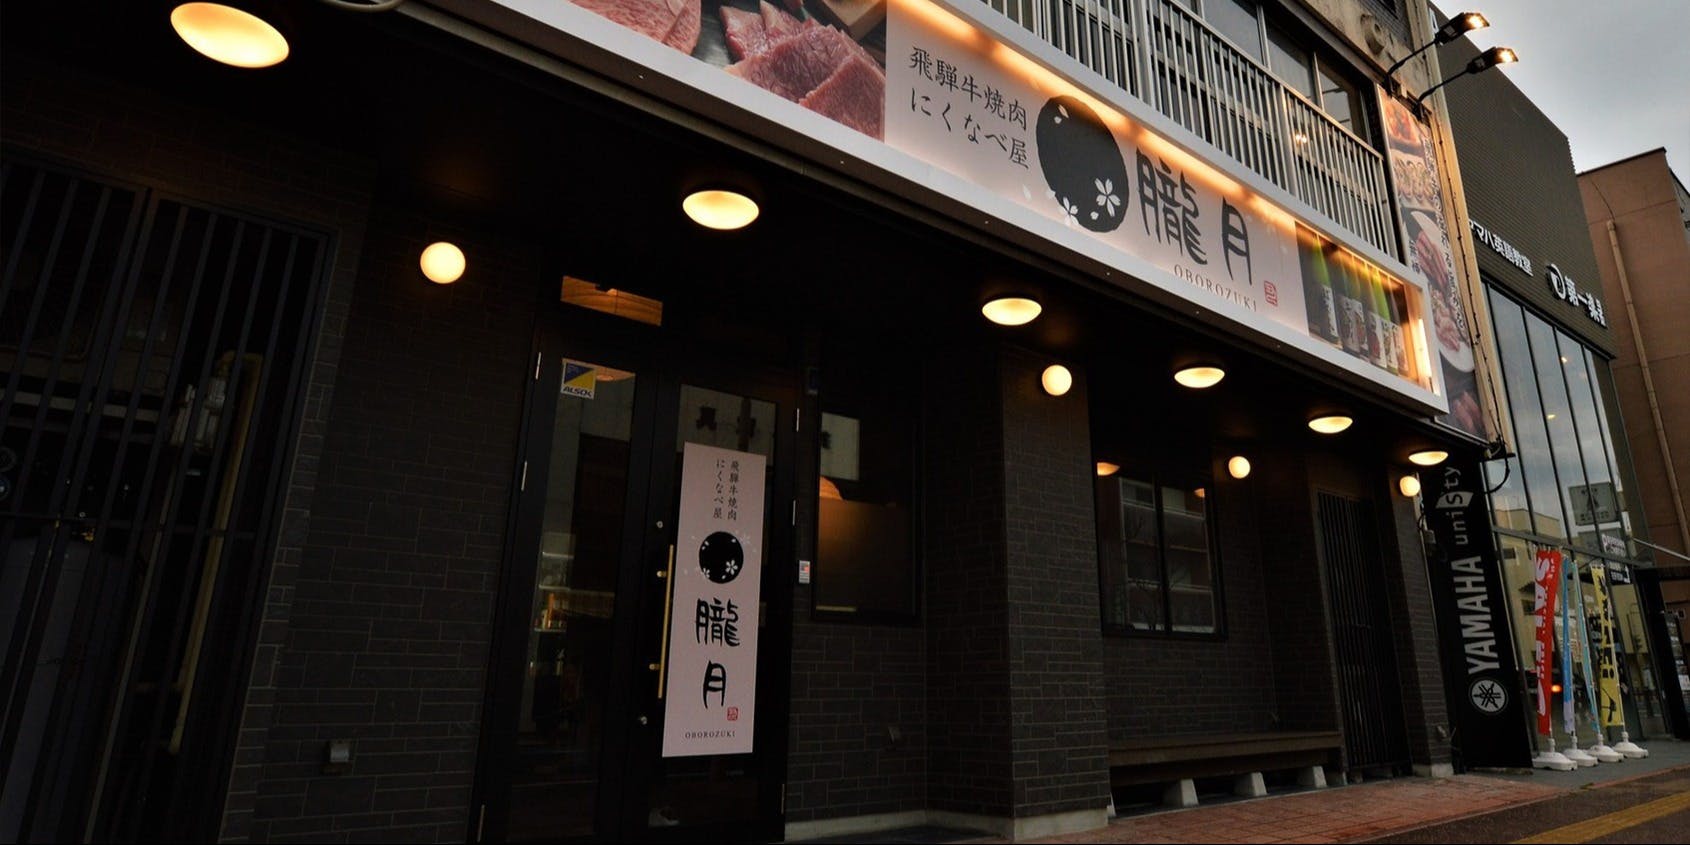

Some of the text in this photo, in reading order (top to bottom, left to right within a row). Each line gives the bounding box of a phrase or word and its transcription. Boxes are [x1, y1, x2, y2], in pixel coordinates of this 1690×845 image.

[909, 46, 1027, 131] 飛騨牛焼肉
[911, 87, 1029, 170] にくなべ屋
[1136, 147, 1253, 286] 朧月
[1173, 264, 1257, 312] OBOROZUKI
[1451, 555, 1500, 674] YAMAHA
[685, 730, 736, 740] OBOROZUKI
